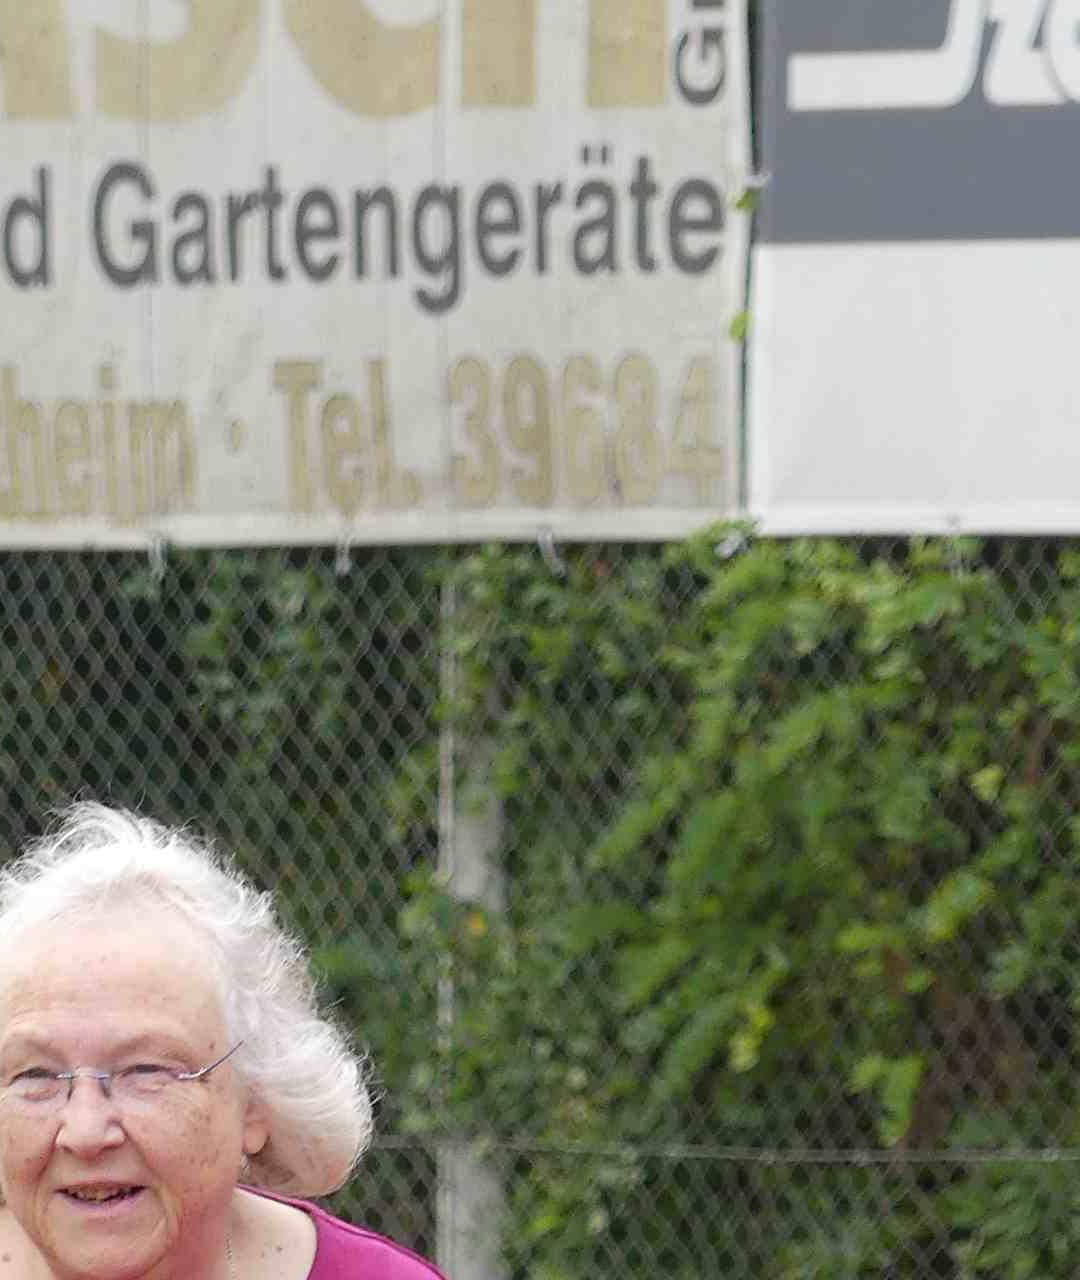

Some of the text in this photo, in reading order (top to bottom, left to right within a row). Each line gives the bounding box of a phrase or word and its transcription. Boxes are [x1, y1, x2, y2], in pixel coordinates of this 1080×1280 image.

[92, 144, 724, 314] Gartengeräte
[272, 356, 420, 514] Tel.
[445, 351, 722, 508] 39684
